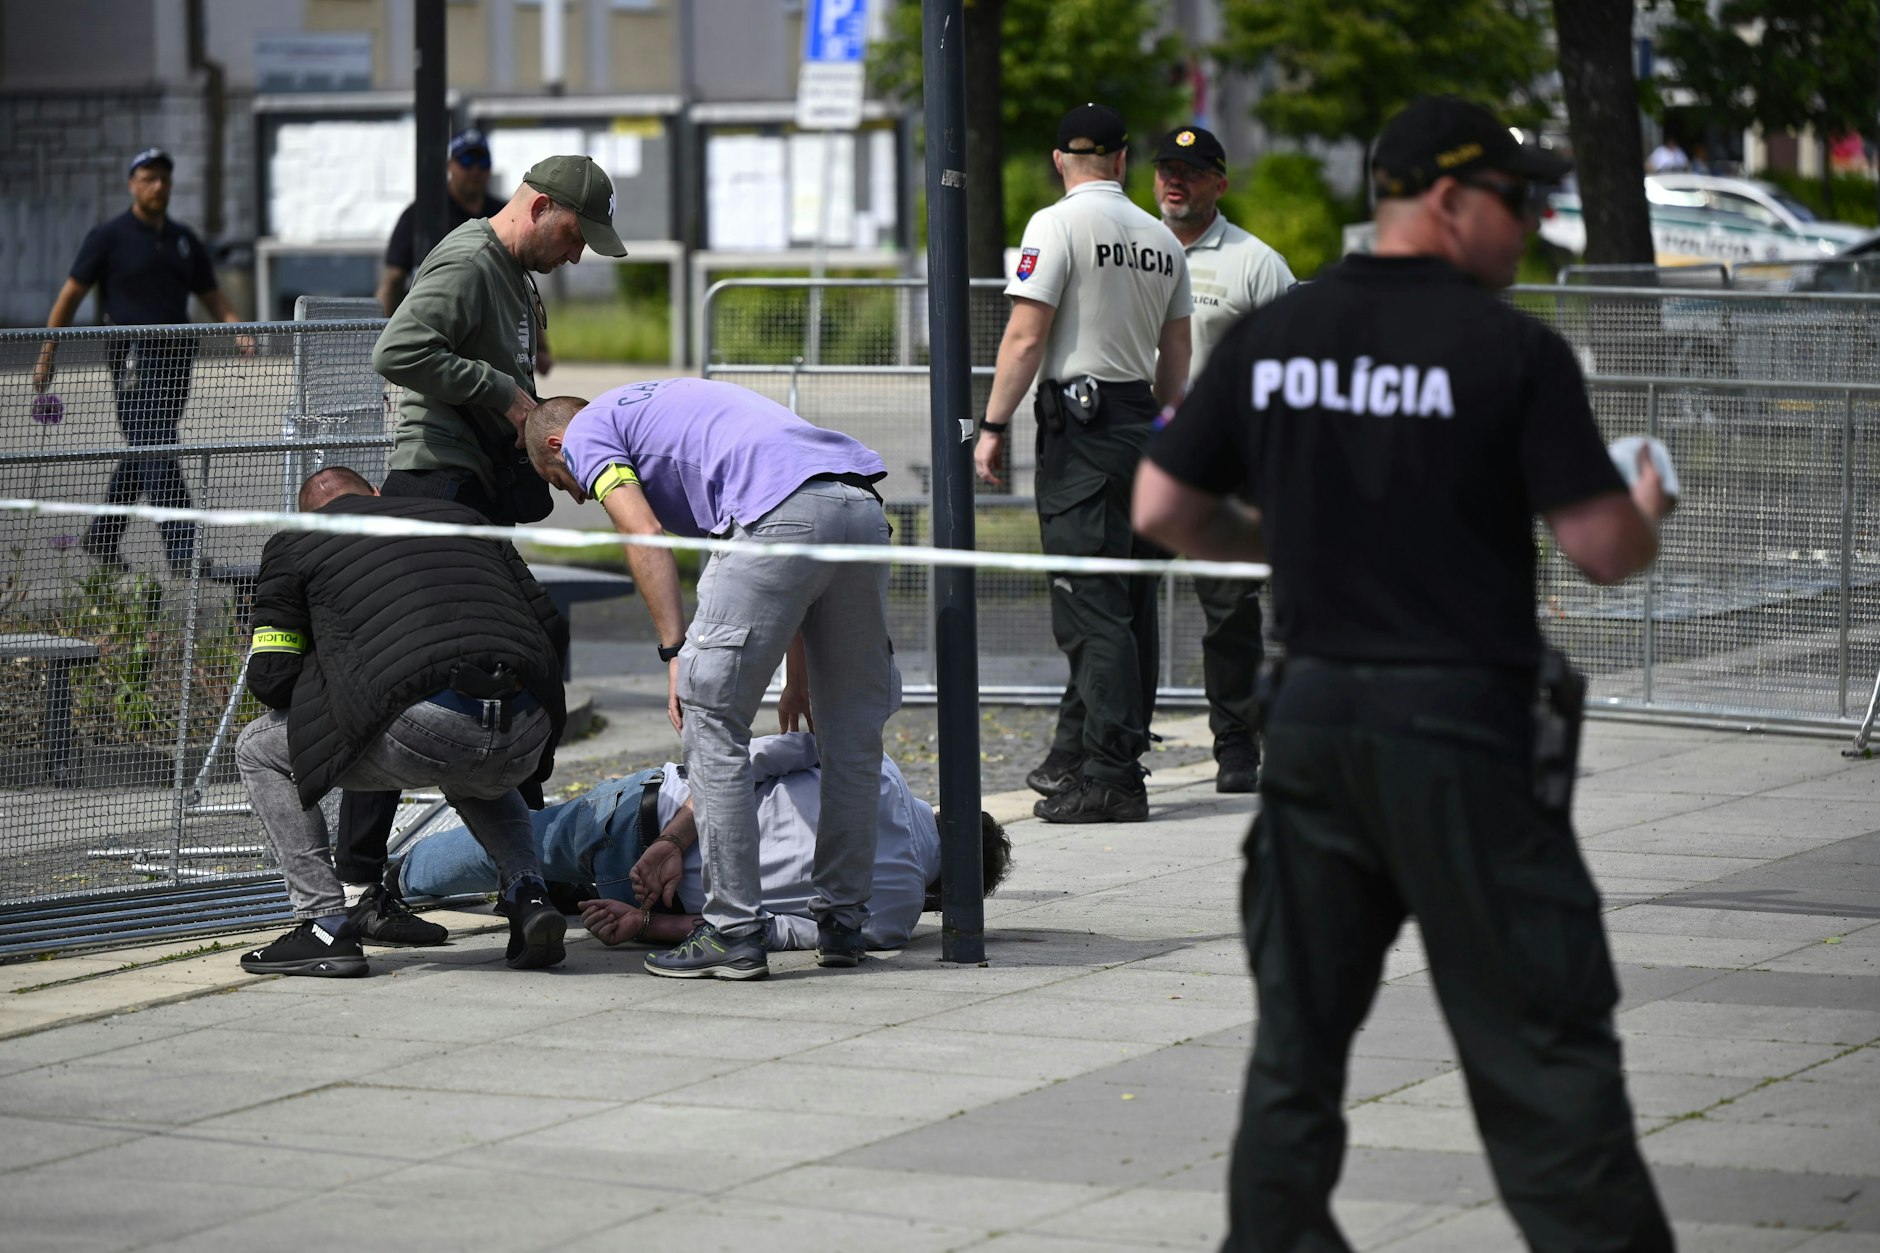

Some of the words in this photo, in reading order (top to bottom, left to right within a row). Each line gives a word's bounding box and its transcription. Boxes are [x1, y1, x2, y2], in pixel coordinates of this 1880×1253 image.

[1096, 241, 1174, 278] POLÍCIA
[1251, 354, 1456, 419] POLÍCIA
[311, 923, 335, 947] PUMA
